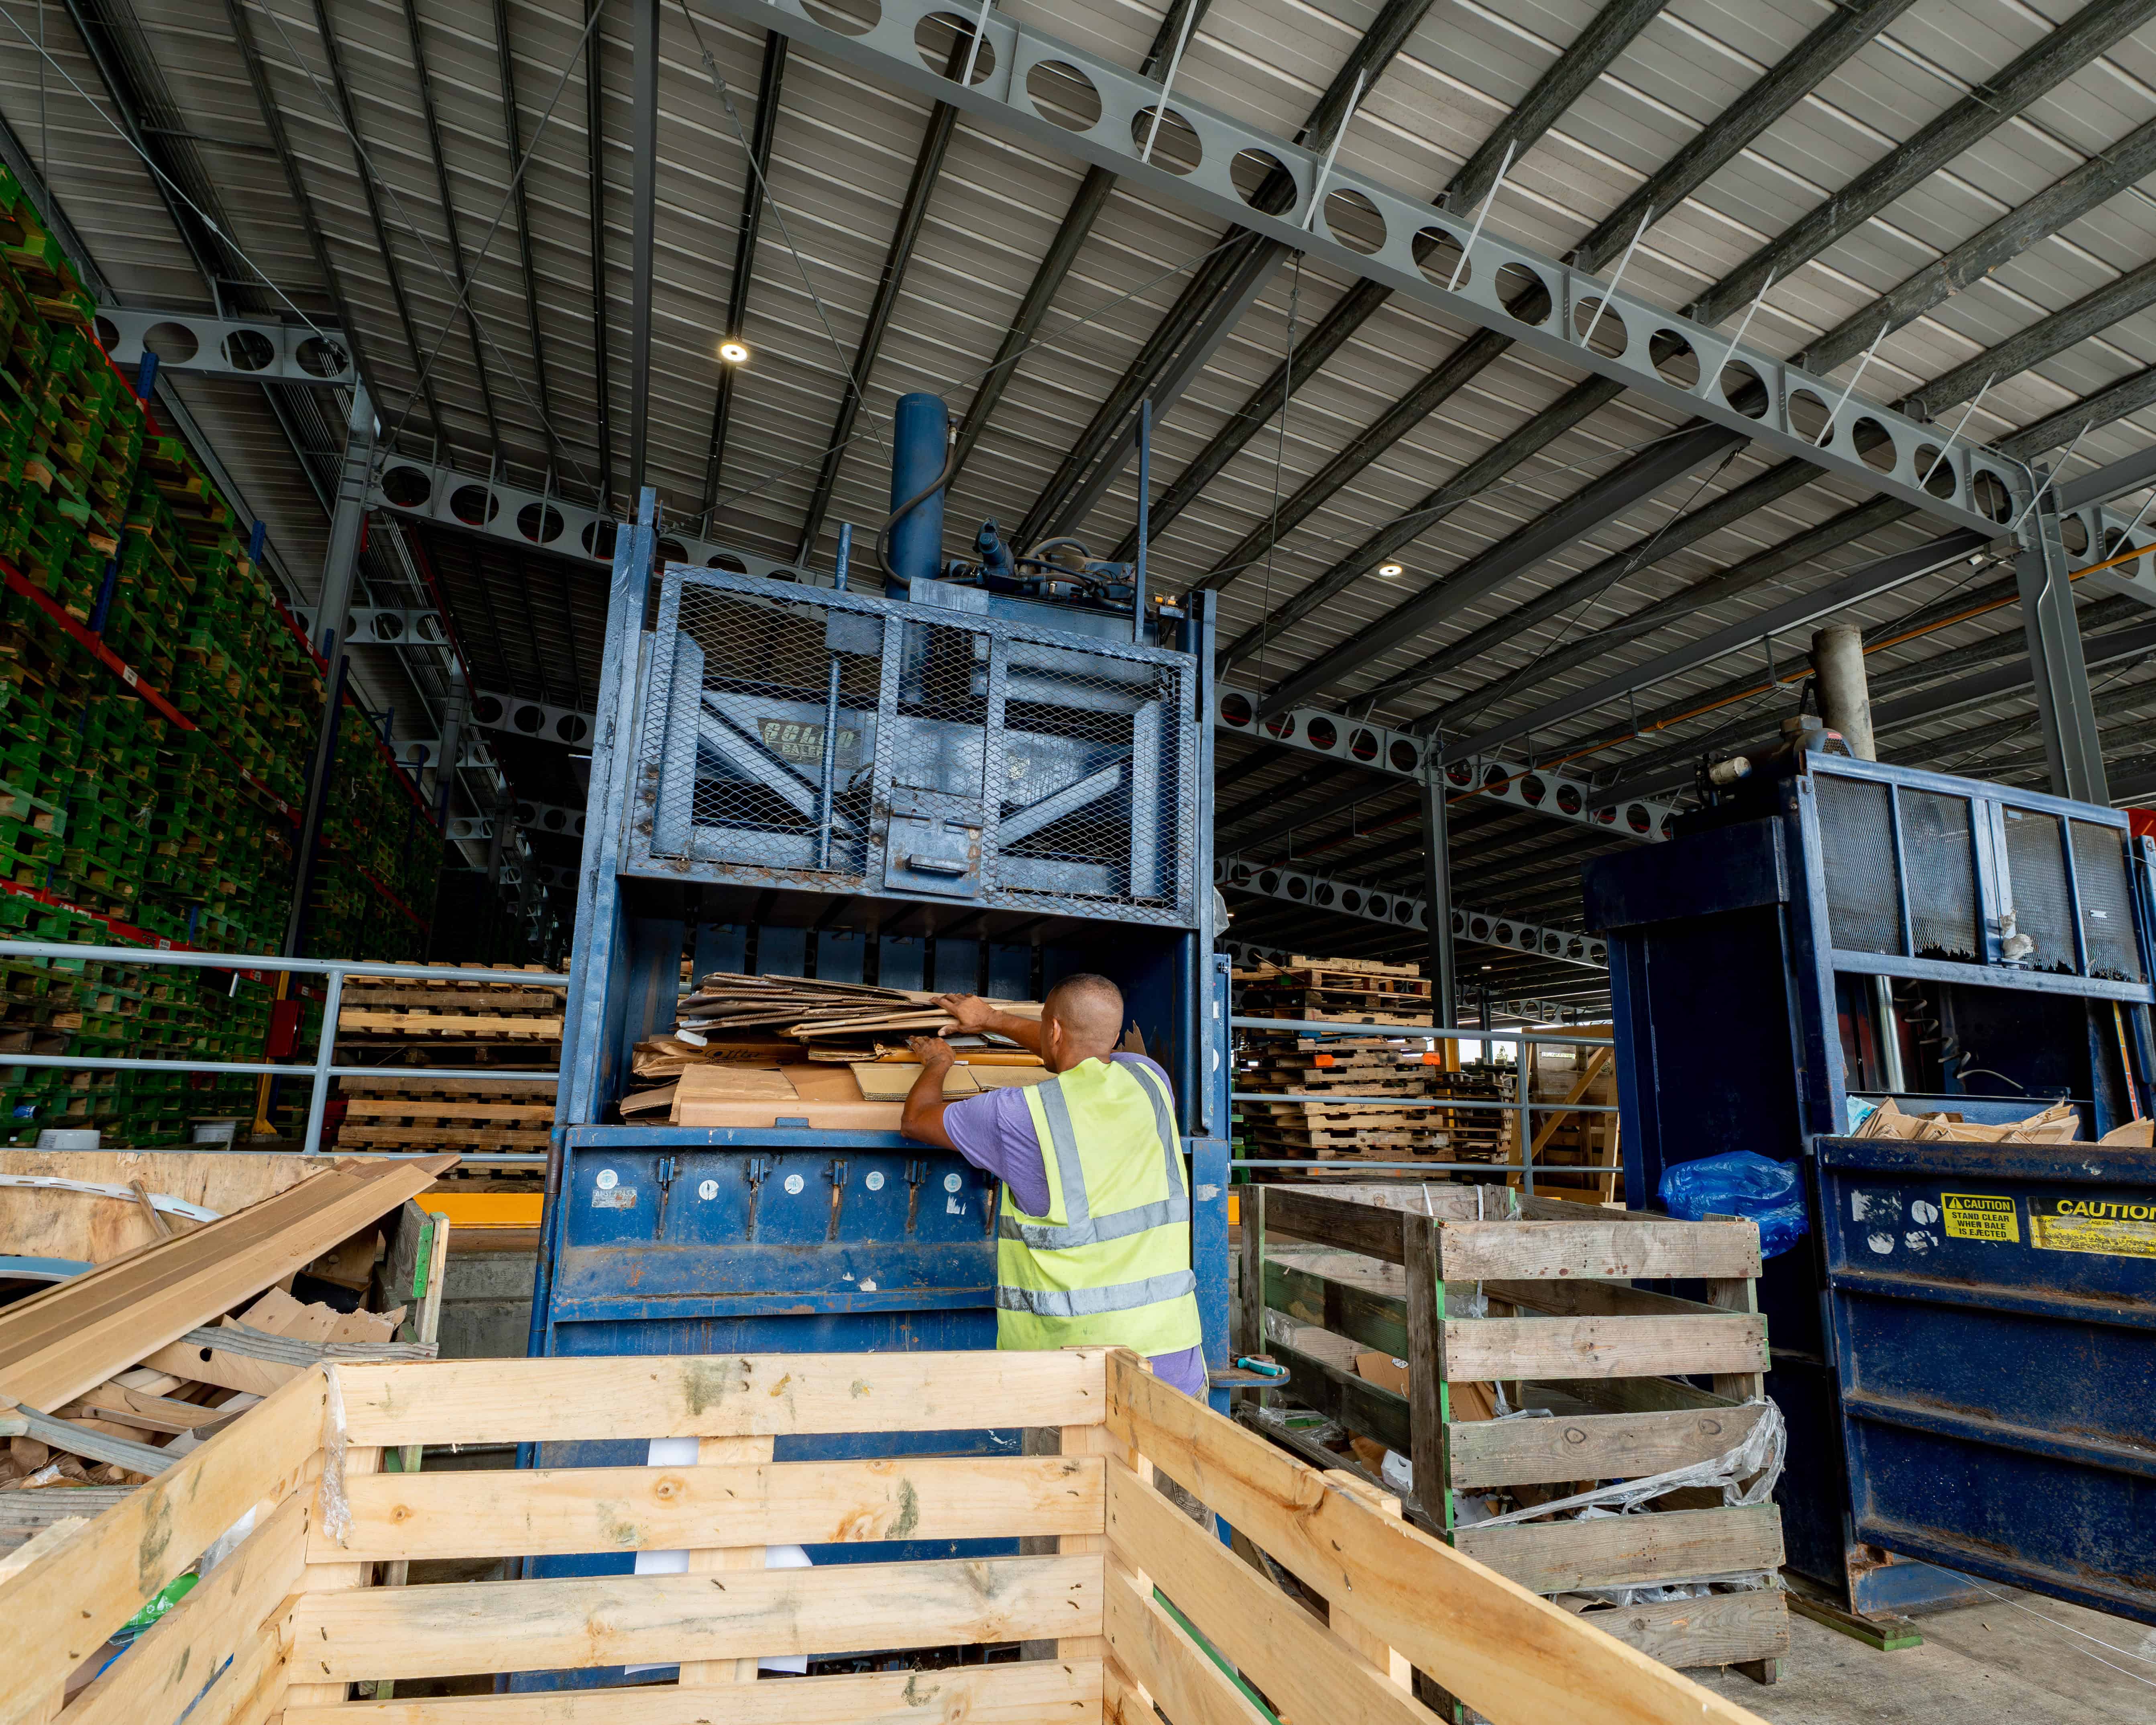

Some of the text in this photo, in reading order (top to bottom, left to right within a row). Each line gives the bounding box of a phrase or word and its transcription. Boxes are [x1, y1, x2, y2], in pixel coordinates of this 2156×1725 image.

[1964, 1199, 2010, 1210] CAUTION
[1982, 1214, 2010, 1222] CLEAR
[1956, 1220, 2007, 1230] WHEN BALE
[1969, 1228, 2007, 1238] EJECTED
